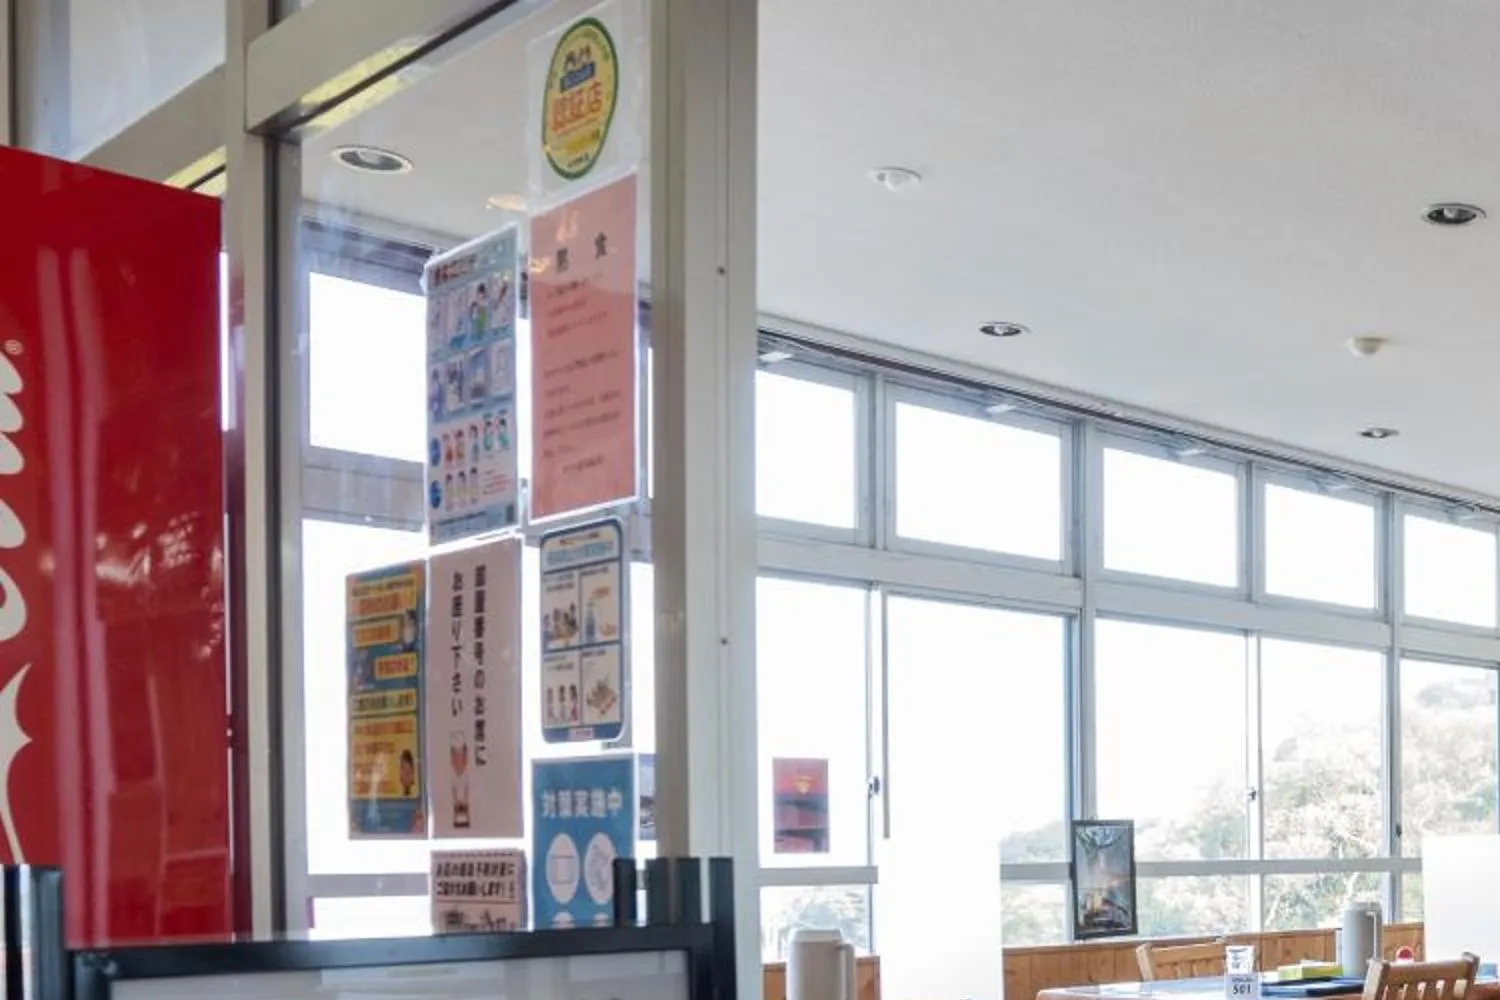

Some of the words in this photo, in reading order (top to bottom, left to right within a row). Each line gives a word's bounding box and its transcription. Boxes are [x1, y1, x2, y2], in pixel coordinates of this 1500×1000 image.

[543, 785, 623, 818] 対策実施中
